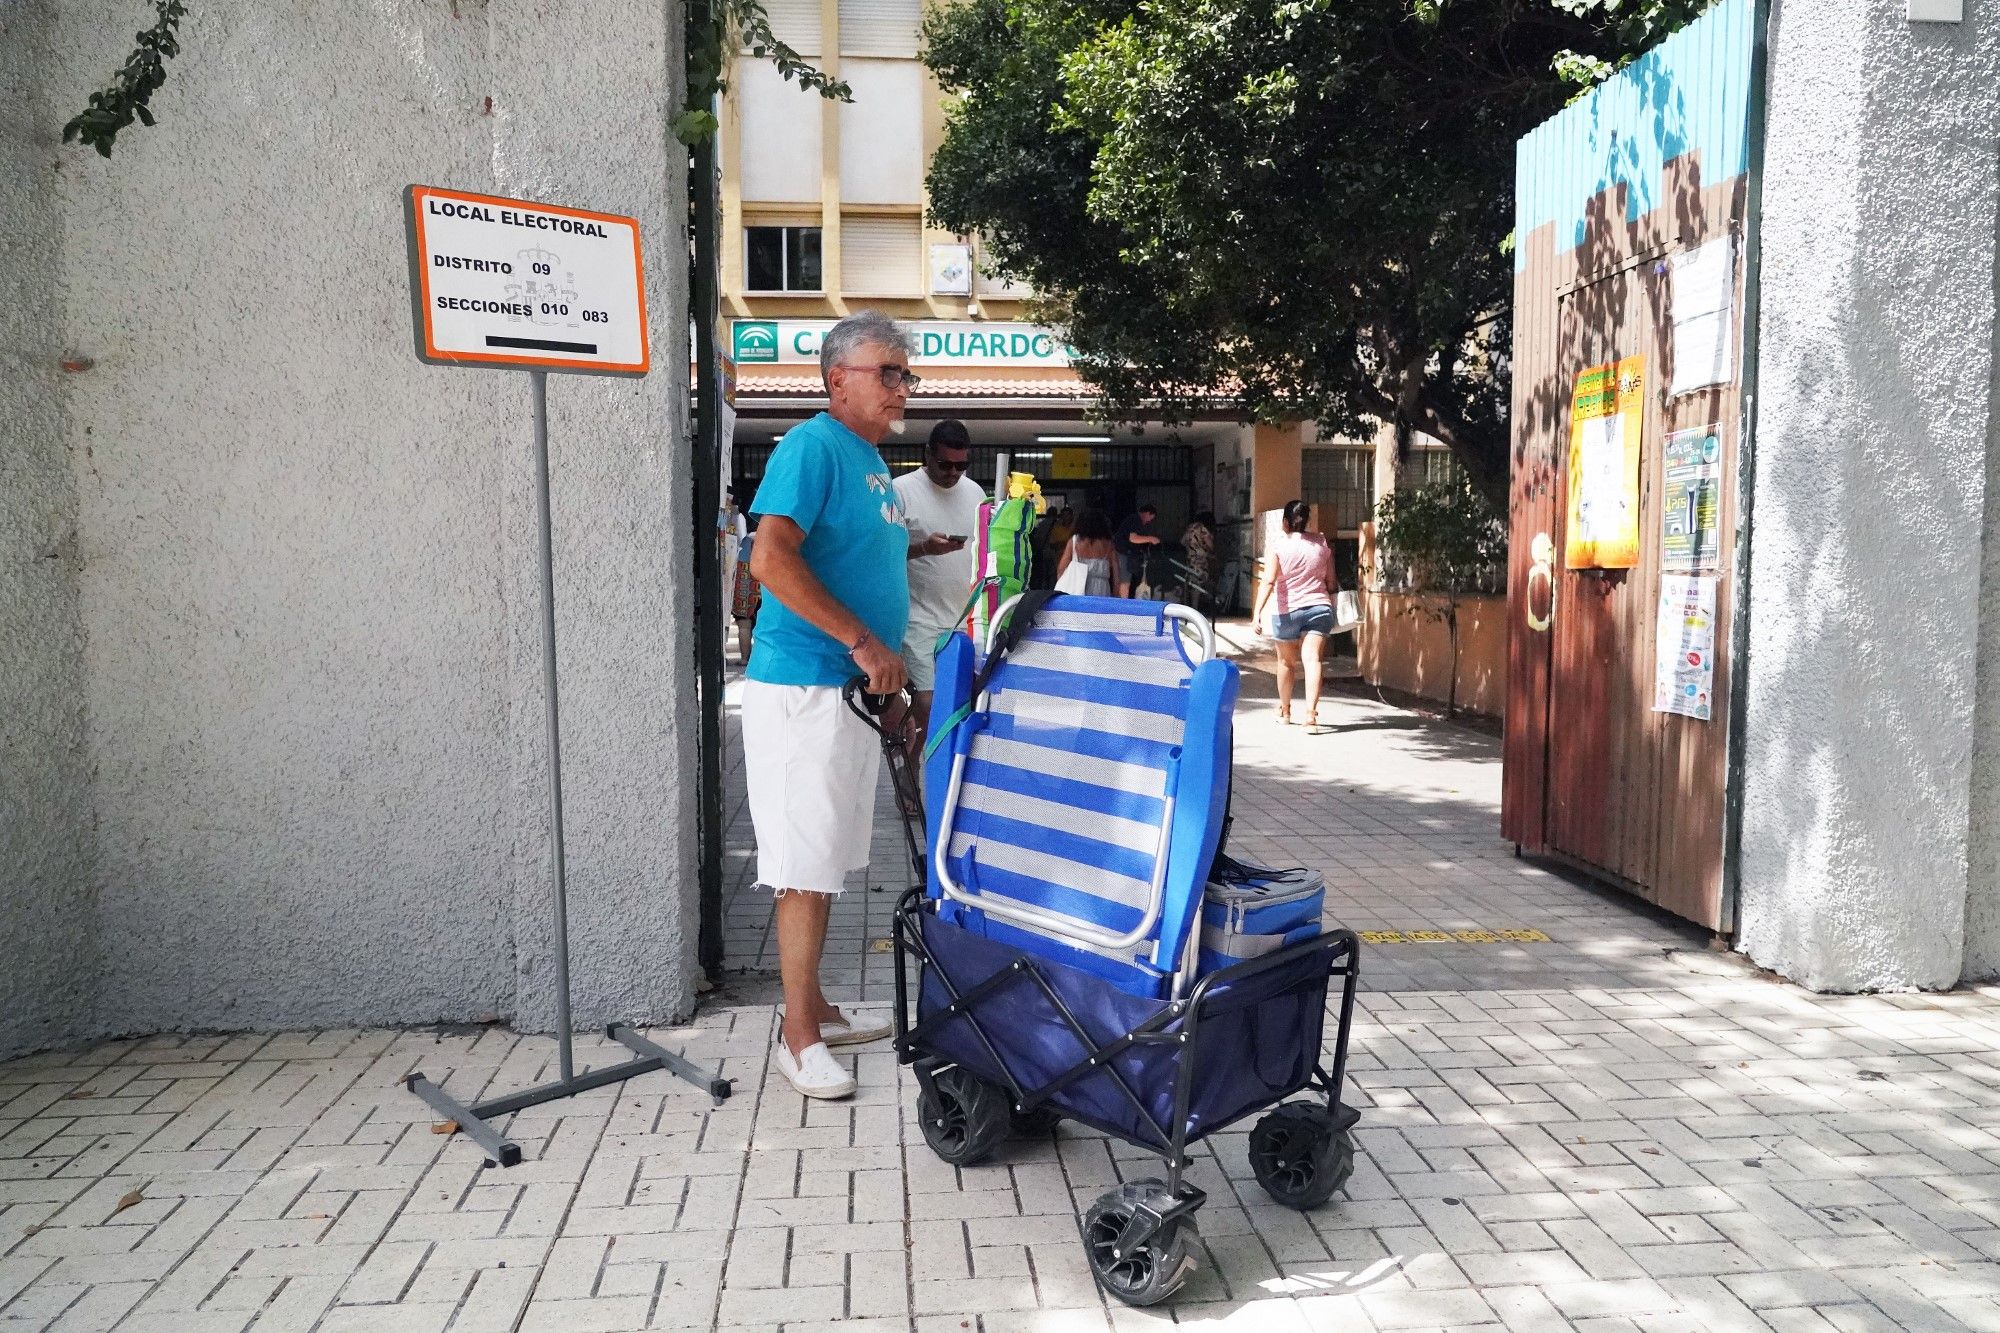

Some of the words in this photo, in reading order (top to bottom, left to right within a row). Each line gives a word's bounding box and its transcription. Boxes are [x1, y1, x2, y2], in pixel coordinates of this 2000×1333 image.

[430, 200, 495, 223] LOCAL
[501, 211, 608, 239] ELECTORAL
[434, 254, 512, 275] DISTRITO
[532, 262, 551, 276] 09
[437, 296, 533, 317] SECCIONES
[541, 302, 569, 316] 010
[582, 309, 609, 323] 083
